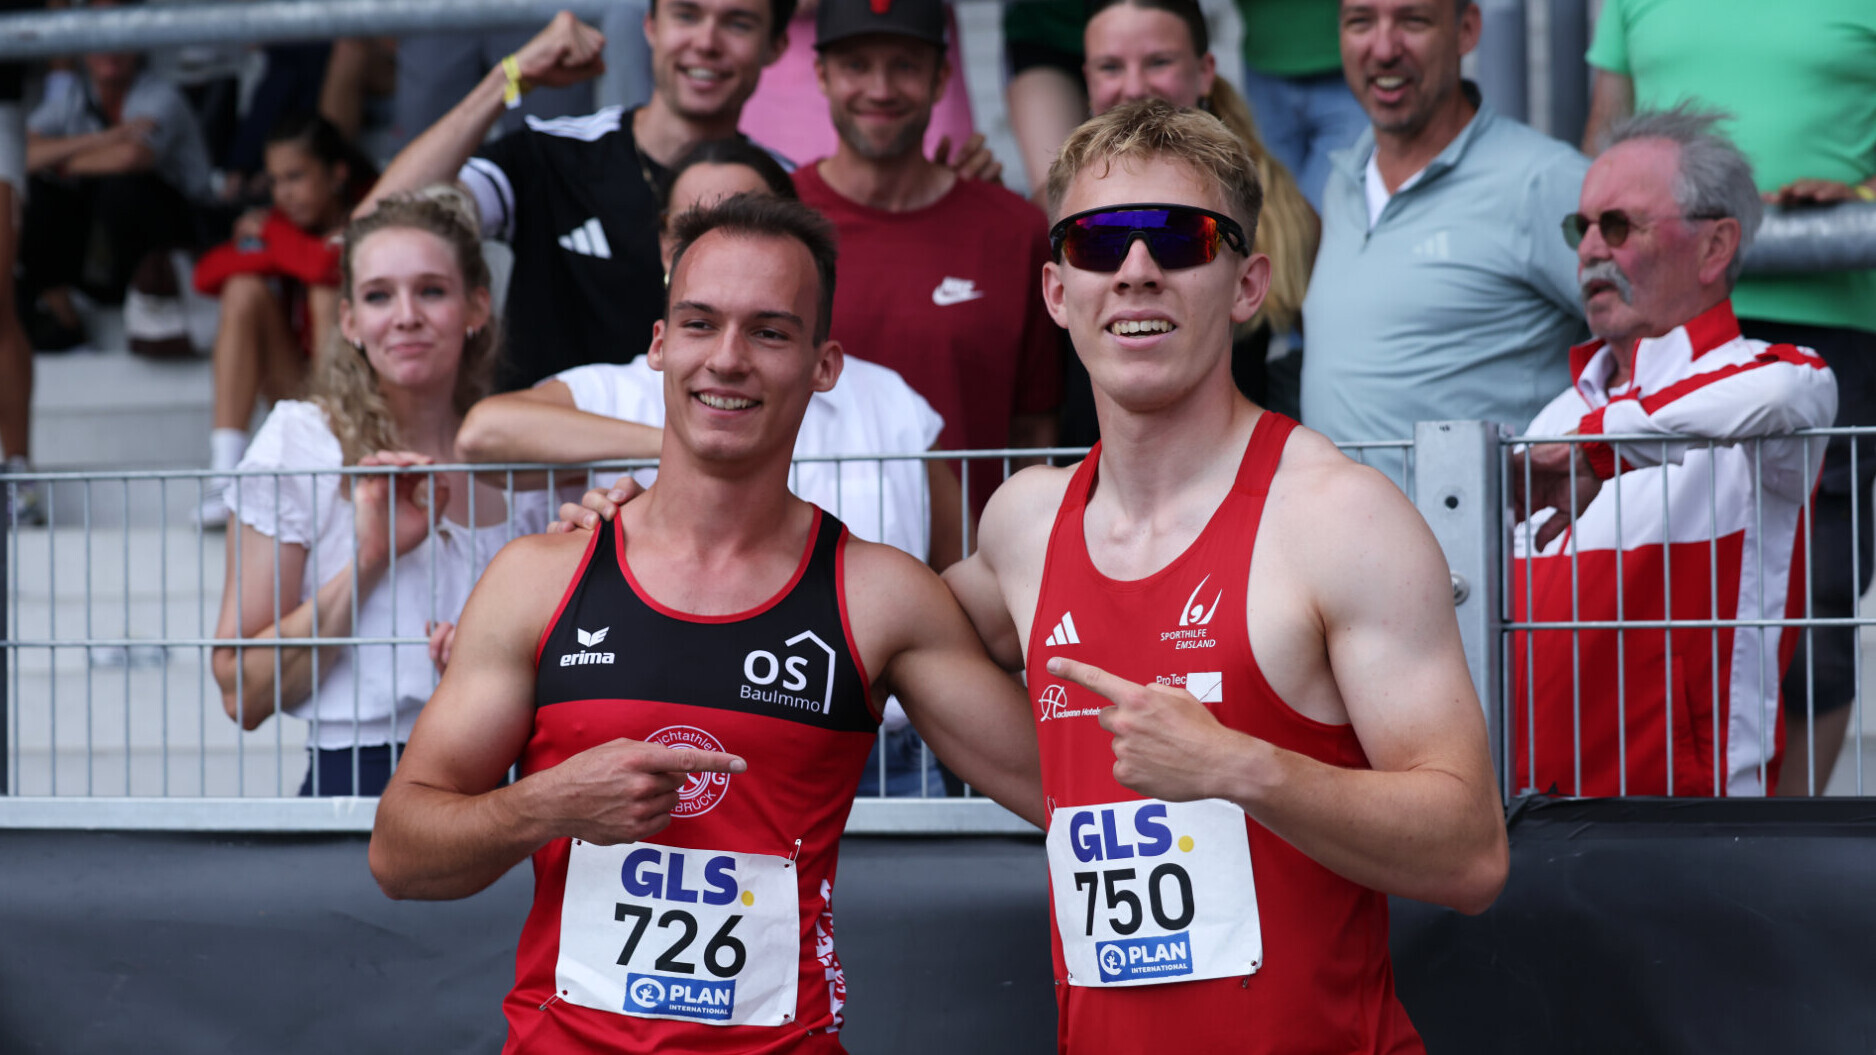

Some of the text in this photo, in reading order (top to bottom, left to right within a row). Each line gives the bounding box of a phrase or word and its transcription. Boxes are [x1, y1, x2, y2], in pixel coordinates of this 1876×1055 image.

[1160, 628, 1207, 641] SPORTHILFE
[1175, 639, 1216, 650] EMSLAND
[560, 650, 615, 667] erima
[743, 650, 809, 692] OS
[740, 685, 820, 713] BauImmo
[1074, 862, 1195, 936] 750
[614, 902, 747, 978] 726
[1128, 941, 1187, 964] PLAN
[1131, 962, 1188, 974] INTERNATIONAL
[669, 985, 731, 1006] PLAN
[669, 1004, 729, 1016] INTERNATIONAL
